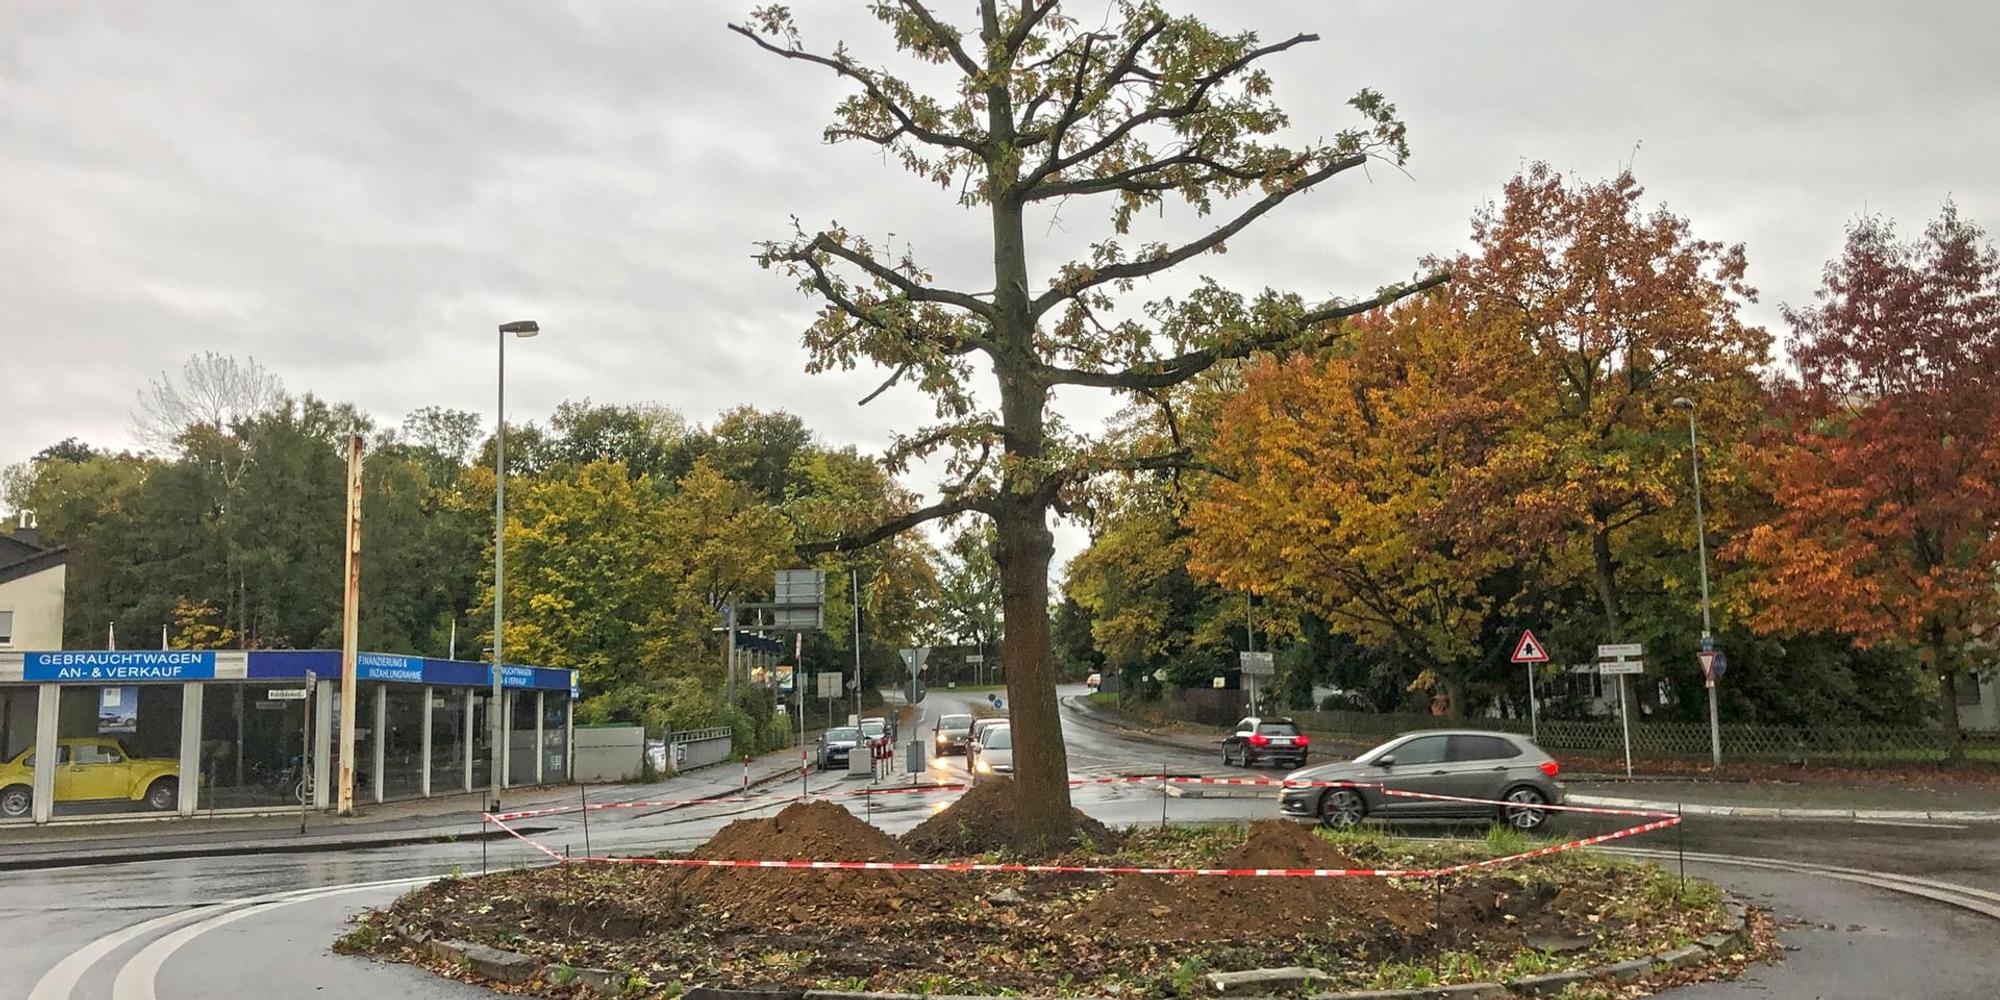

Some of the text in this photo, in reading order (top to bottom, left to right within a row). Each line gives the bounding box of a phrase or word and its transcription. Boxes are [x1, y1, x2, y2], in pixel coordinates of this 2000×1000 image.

[39, 654, 202, 665] GEBRAUCHTWAGEN
[358, 656, 402, 667] FINANZIERUNG
[58, 666, 182, 678] AN- & VERKAUF
